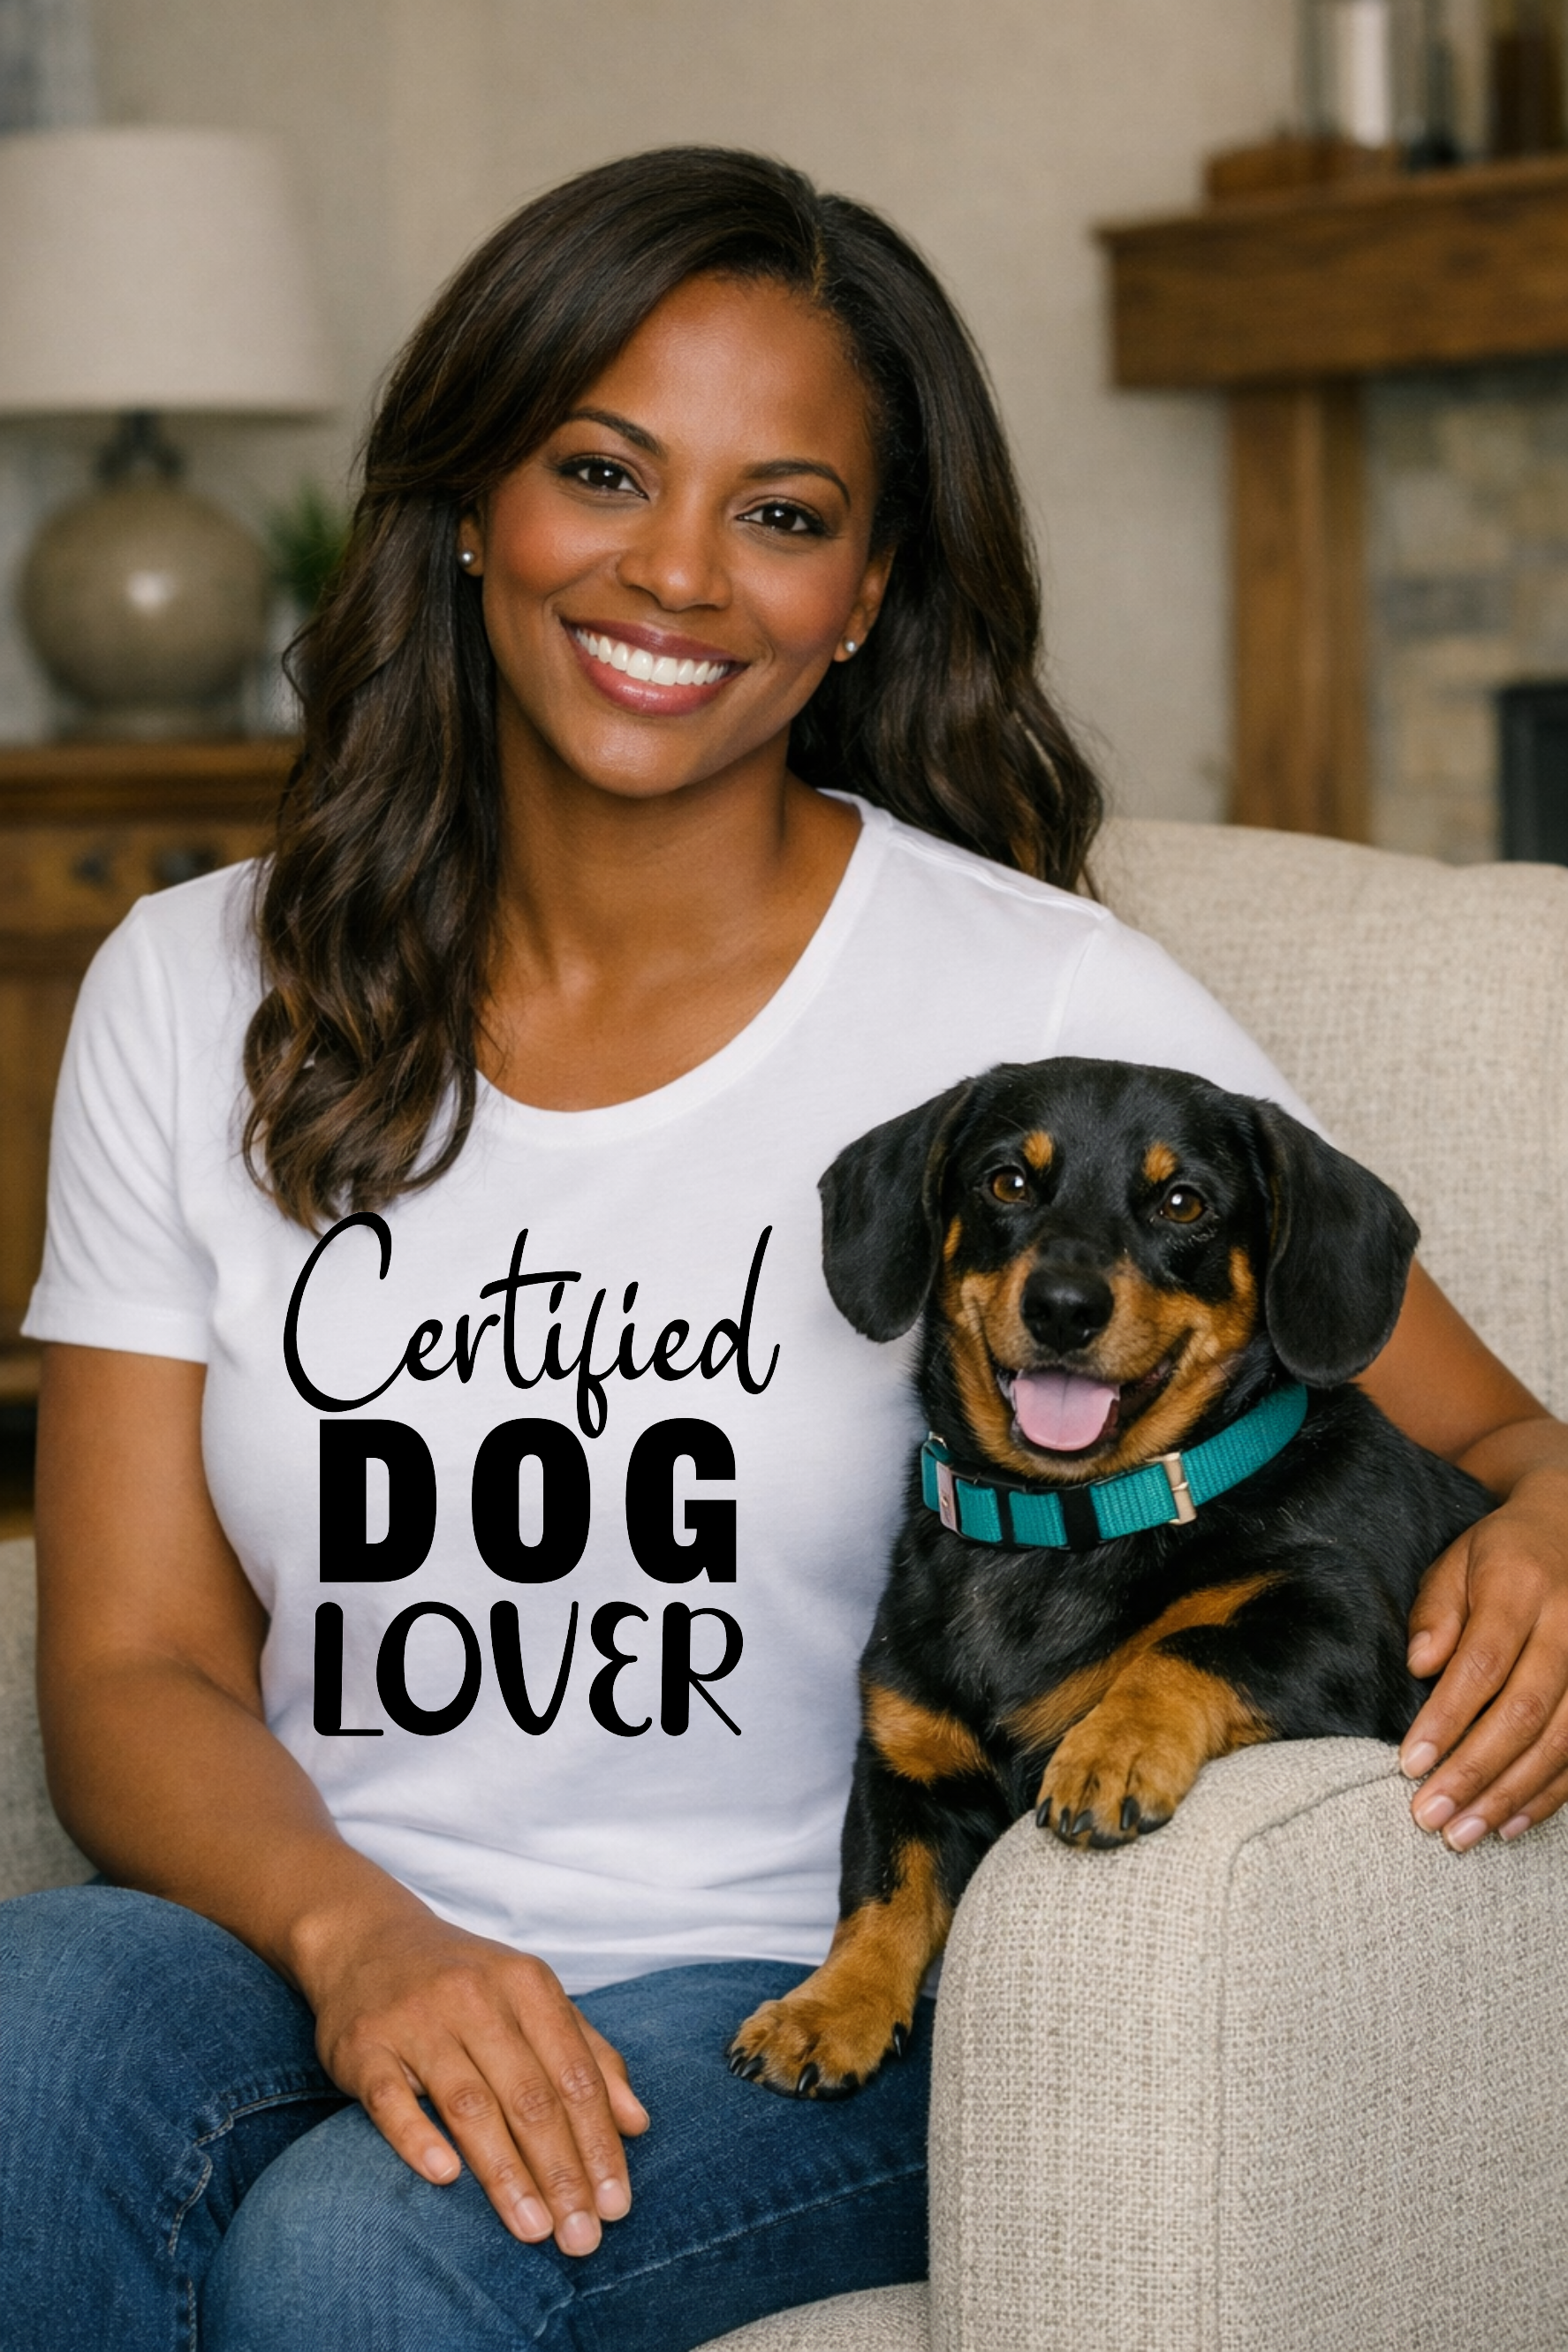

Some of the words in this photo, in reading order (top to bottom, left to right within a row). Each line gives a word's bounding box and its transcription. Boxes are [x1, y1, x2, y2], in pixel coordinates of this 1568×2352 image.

[283, 1210, 781, 1439] Certified
[319, 1417, 737, 1584] DOG
[313, 1600, 744, 1738] LOVER
